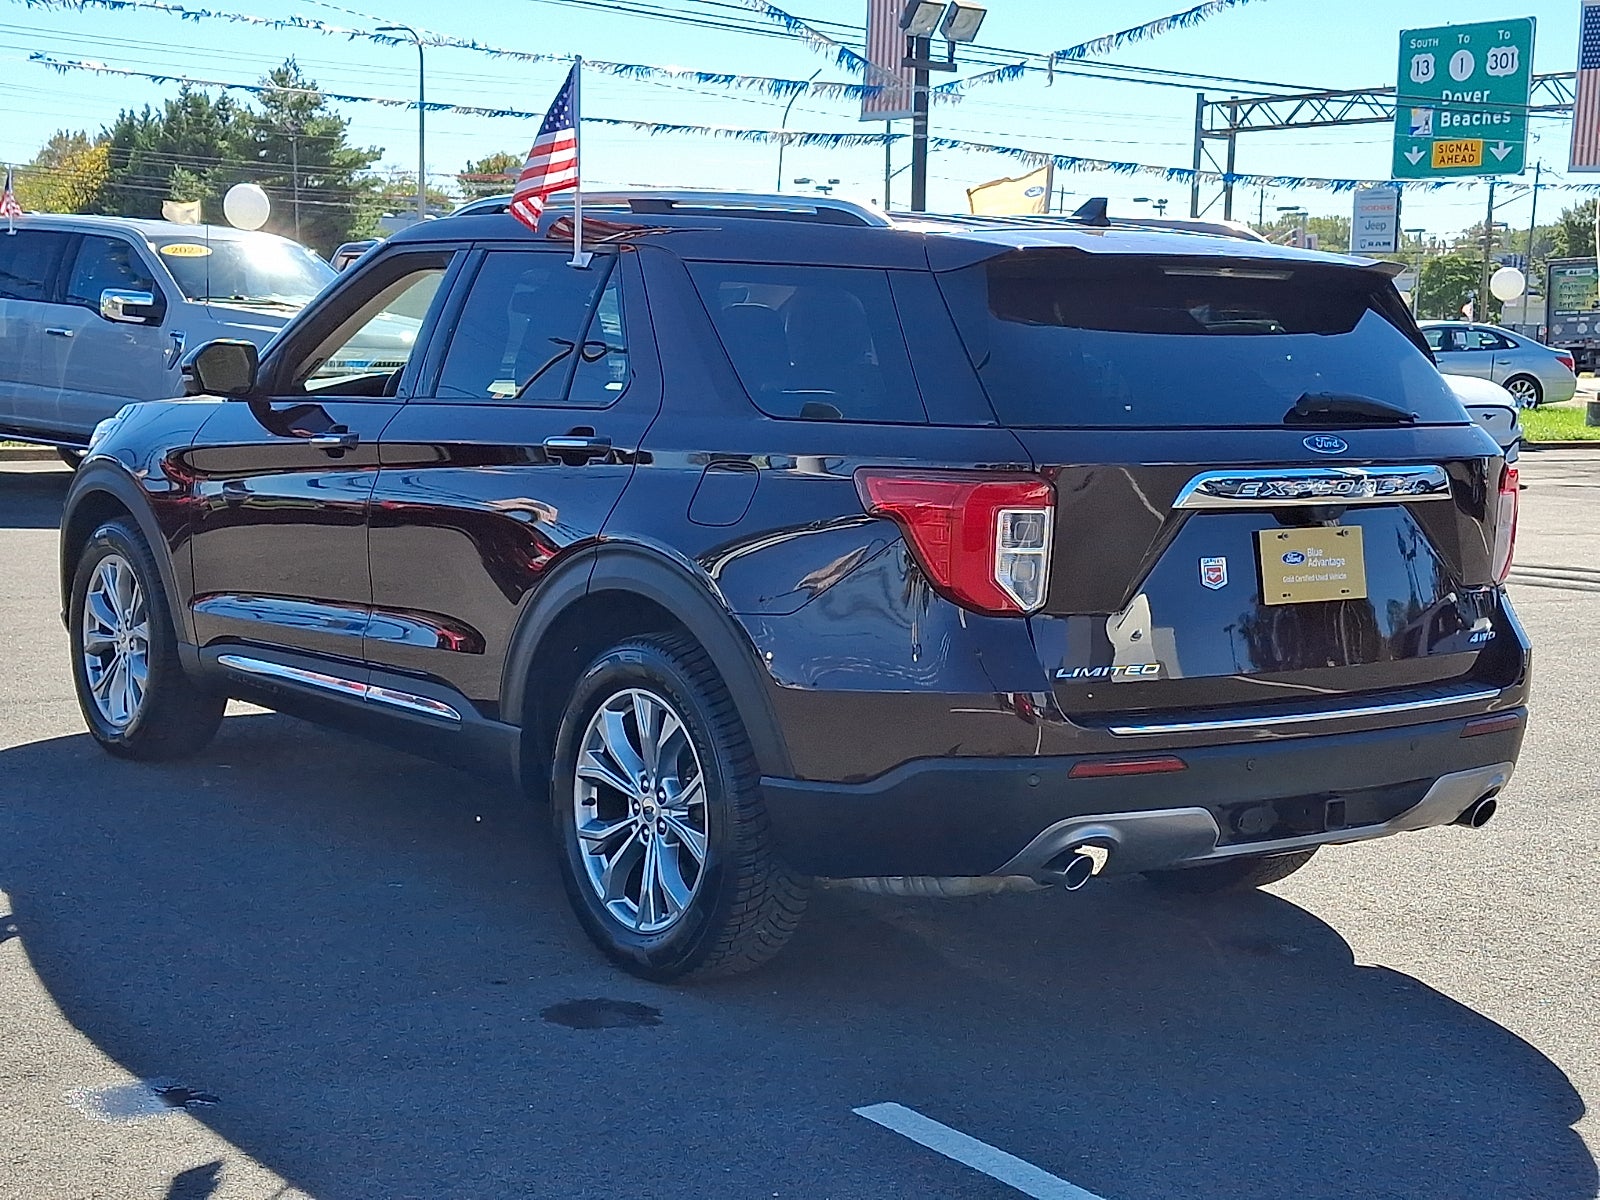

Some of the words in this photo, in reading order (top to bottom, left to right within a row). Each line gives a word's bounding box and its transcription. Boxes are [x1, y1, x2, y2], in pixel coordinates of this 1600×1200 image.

[1410, 38, 1439, 49] SOUTH
[1416, 59, 1430, 76] 13
[1459, 57, 1464, 74] 1
[1489, 52, 1515, 70] 301
[1442, 90, 1490, 105] Dover
[1440, 110, 1511, 127] Beaches
[1438, 142, 1476, 154] SIGNAL
[1439, 154, 1475, 164] AHEAD
[1365, 220, 1387, 232] Jeep
[1315, 436, 1339, 448] Ford
[1235, 478, 1425, 498] EXPLORER
[1285, 552, 1301, 563] Ford
[1307, 547, 1323, 557] Blue
[1307, 557, 1346, 568] Advantage
[1295, 574, 1315, 582] Certified
[1315, 573, 1328, 581] Used
[1056, 664, 1160, 678] LIMITED
